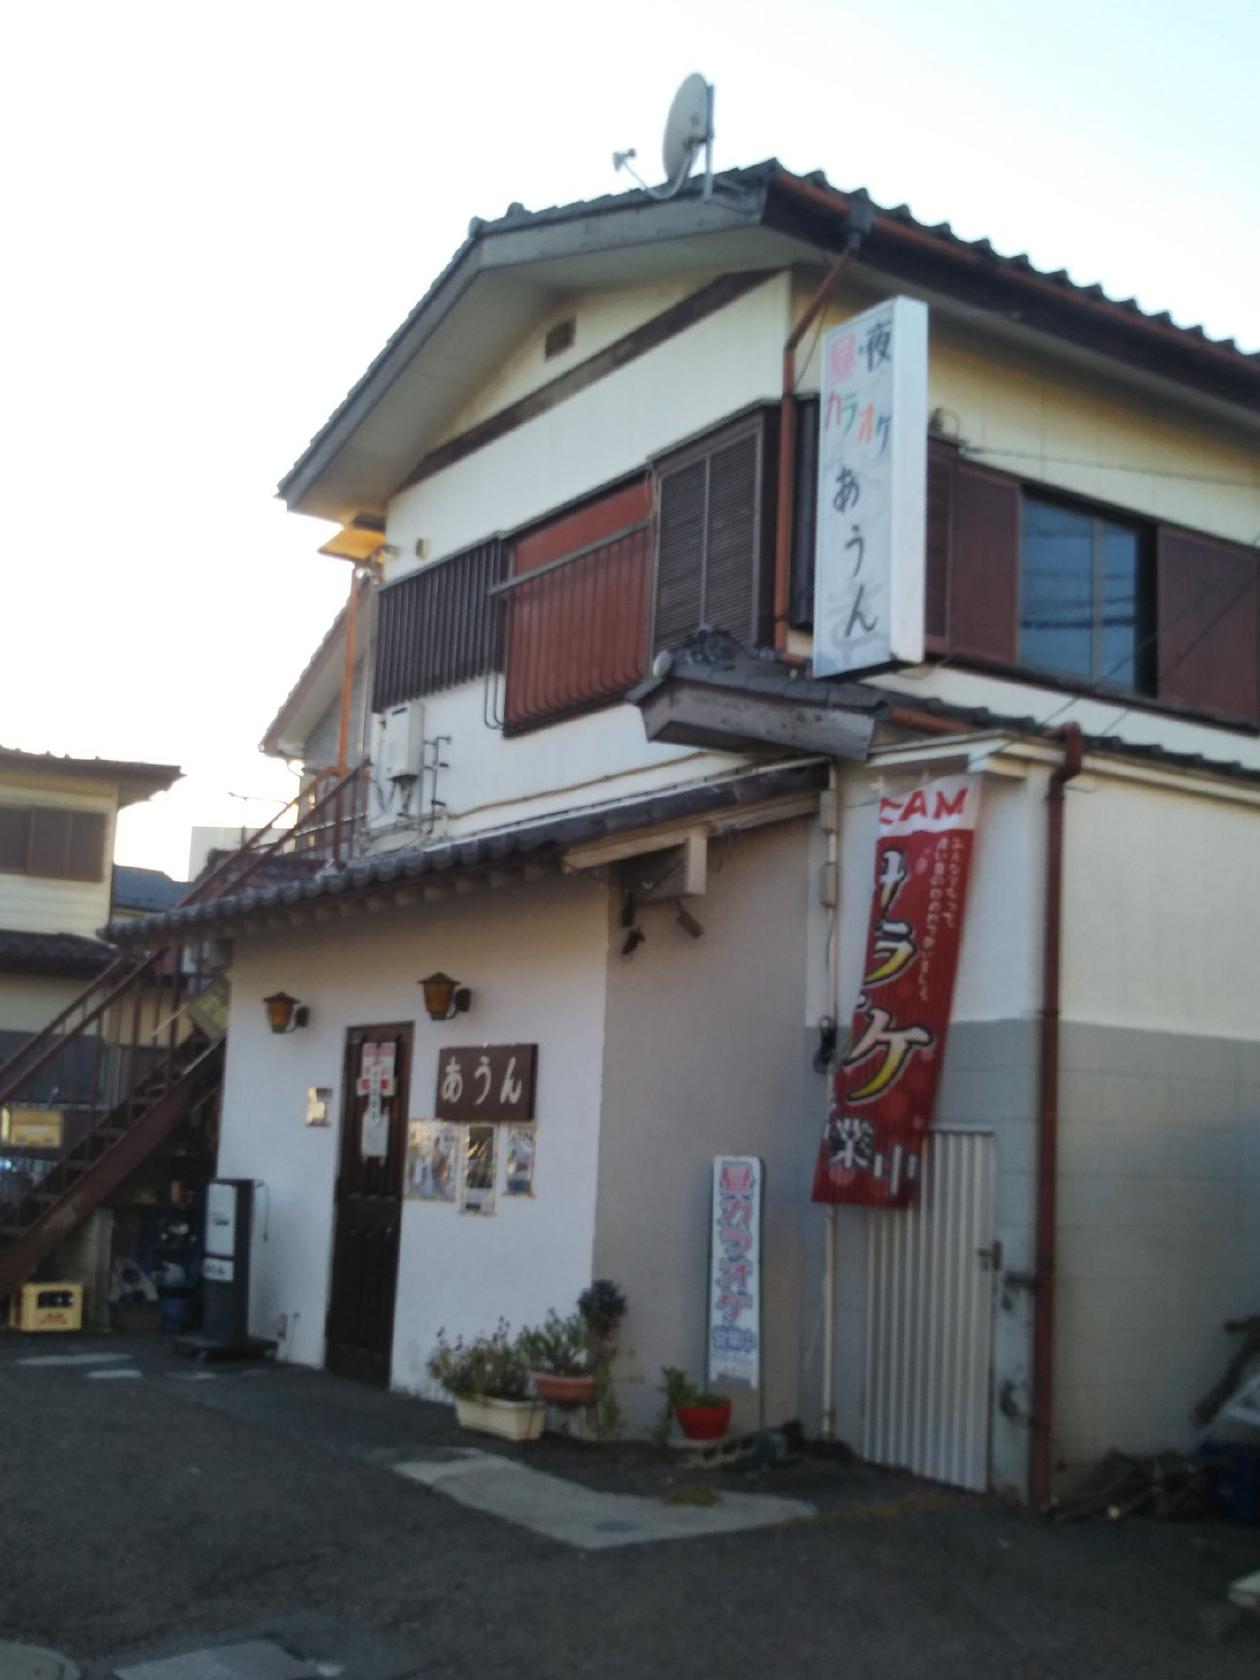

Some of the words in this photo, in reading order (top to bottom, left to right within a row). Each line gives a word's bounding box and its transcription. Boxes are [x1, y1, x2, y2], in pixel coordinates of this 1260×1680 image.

[824, 389, 892, 457] カラオケ
[833, 466, 878, 638] あうん
[842, 849, 934, 1104] カラケ
[441, 1055, 523, 1107] あうん
